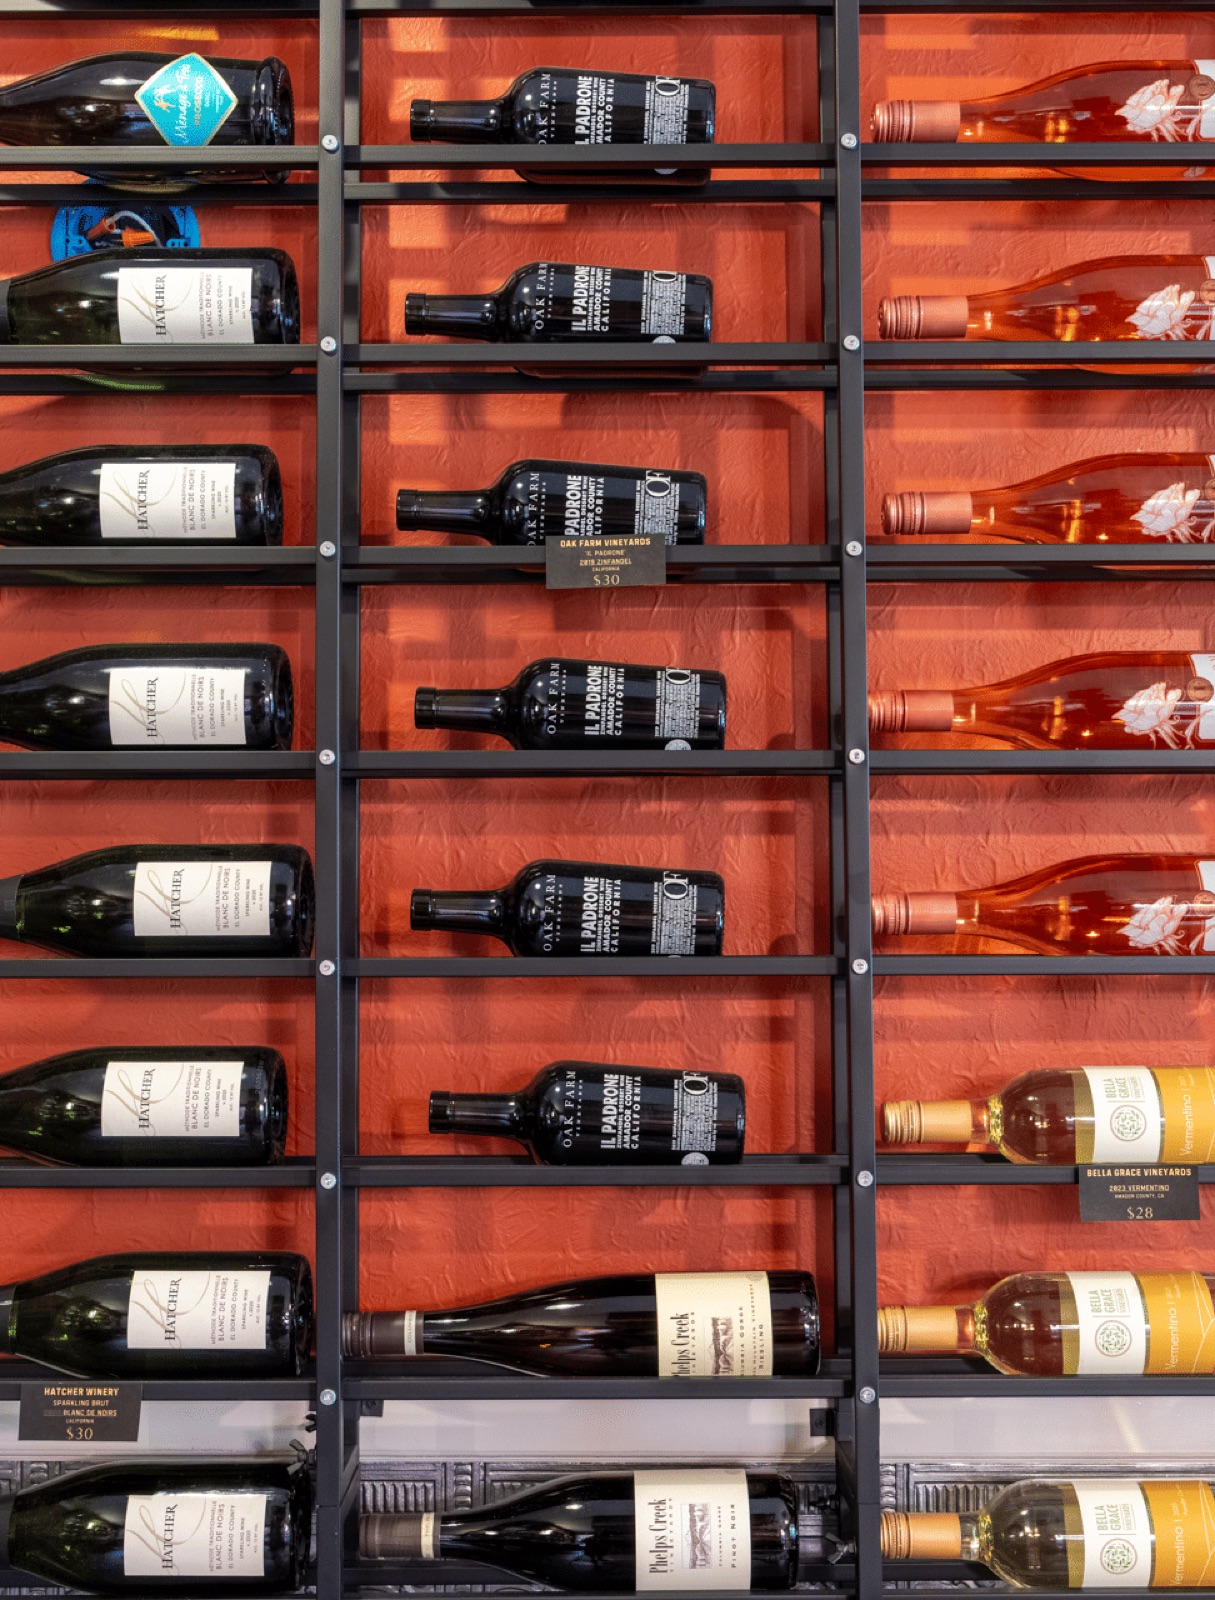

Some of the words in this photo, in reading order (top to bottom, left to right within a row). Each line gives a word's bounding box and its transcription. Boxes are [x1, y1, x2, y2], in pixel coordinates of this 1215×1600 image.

[540, 74, 550, 108] FARM
[575, 75, 592, 135] PADRONE
[605, 78, 615, 142] ALIFORNIA
[596, 110, 604, 144] MADOR
[156, 275, 166, 335] HATCHER
[205, 298, 211, 308] DE
[573, 266, 590, 315] PADRONE
[601, 269, 611, 332] CALIFORNIA
[535, 297, 545, 330] OAK
[572, 319, 586, 331] IL
[594, 304, 602, 332] AMADOR
[189, 494, 194, 504] DE
[529, 473, 540, 511] FARM
[588, 477, 596, 509] COUNTY
[645, 470, 671, 497] OF
[137, 470, 150, 530] HATCHER
[564, 475, 582, 535] PADRONE
[595, 477, 604, 535] LIFORNIA
[586, 504, 595, 536] ADOR
[579, 539, 602, 547] FARM
[604, 538, 651, 546] VINEYARDS
[593, 574, 620, 586] $30
[549, 663, 560, 695] FARM
[585, 665, 602, 720] PADRONE
[147, 677, 159, 737] HATCHER
[198, 701, 204, 711] DE
[615, 668, 625, 735] CALIFORNIA
[548, 703, 558, 734] OAK
[585, 724, 600, 735] IL
[606, 702, 615, 735] AMADOR
[223, 868, 231, 889] NOIRS
[544, 874, 556, 914] FARM
[664, 871, 688, 899] OF
[170, 869, 185, 928] HATCHER
[222, 892, 229, 901] DE
[581, 876, 599, 938] PADRONE
[611, 879, 621, 952] CALIFORNIA
[543, 922, 554, 951] OAK
[581, 938, 596, 952] IL
[603, 914, 611, 952] AMADOR
[194, 1068, 202, 1089] NOIRS
[565, 1071, 576, 1108] FARM
[625, 1076, 633, 1105] COUNTY
[683, 1071, 708, 1095] OF
[1104, 1078, 1116, 1098] BELLA
[1115, 1077, 1130, 1098] GRACE
[139, 1068, 156, 1129] HATCHER
[192, 1092, 199, 1101] DE
[602, 1074, 619, 1134] PADRONE
[631, 1076, 641, 1149] CALIFORNIA
[564, 1116, 574, 1148] OAK
[1180, 1094, 1194, 1156] Vermentino
[601, 1137, 616, 1149] IL
[1087, 1169, 1112, 1177] BELLA
[1144, 1168, 1191, 1176] VINEYARDS
[1127, 1206, 1153, 1219] $28
[221, 1277, 229, 1299] NOIRS
[1089, 1289, 1102, 1313] BELLA
[1100, 1289, 1116, 1313] GRACE
[165, 1278, 182, 1341] HATCHER
[218, 1302, 226, 1312] DE
[670, 1313, 689, 1345] Creek
[1165, 1307, 1180, 1370] Vermentino
[44, 1387, 84, 1396] HATCHER
[86, 1387, 119, 1396] WINERY
[66, 1426, 93, 1440] $30
[648, 1498, 667, 1531] Creek
[1095, 1505, 1108, 1531] BELLA
[1107, 1504, 1121, 1531] GRACE
[162, 1504, 178, 1569] HATCHER
[216, 1530, 223, 1541] DE
[648, 1536, 674, 1573] Phelps
